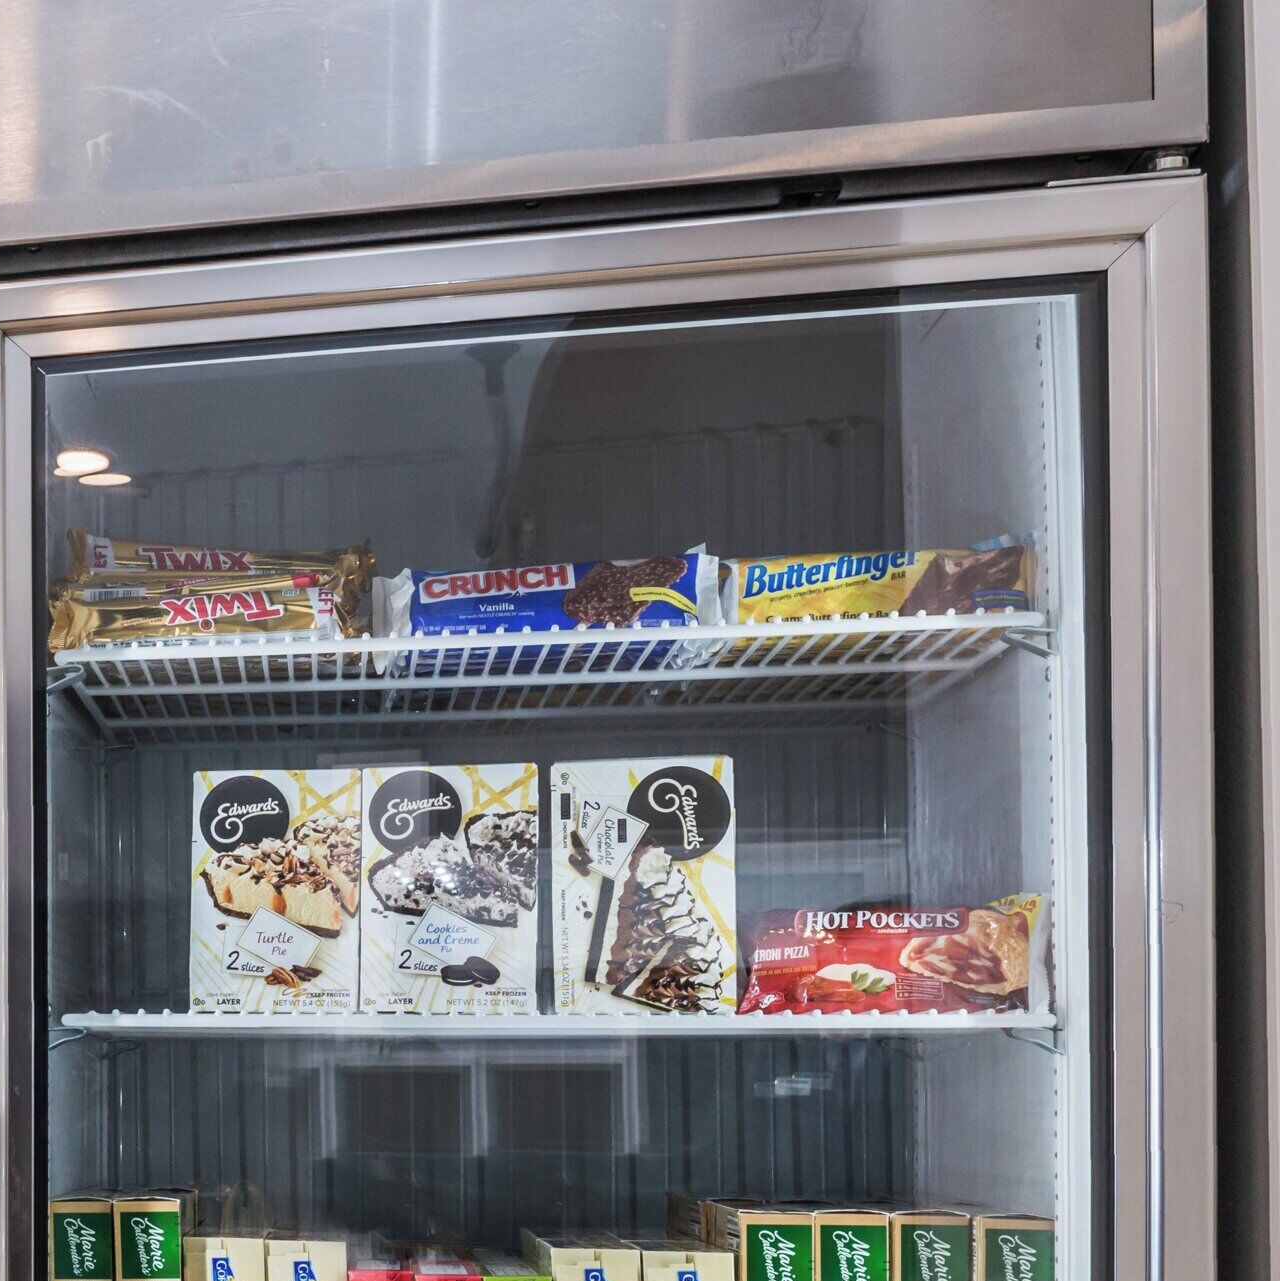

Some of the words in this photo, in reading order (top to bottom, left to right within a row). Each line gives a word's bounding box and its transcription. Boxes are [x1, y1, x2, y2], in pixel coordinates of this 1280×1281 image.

[423, 564, 571, 599] CRUNCH
[742, 550, 919, 599] Butterfinger
[891, 570, 906, 581] BAR
[478, 602, 515, 612] Vanilla
[210, 798, 280, 843] Edwards
[380, 793, 452, 840] Edwards
[648, 778, 704, 850] Edwards
[604, 818, 613, 866] Chocolate
[426, 923, 468, 935] Cookies
[806, 911, 853, 930] HOT
[856, 910, 959, 929] POCKETS
[255, 931, 294, 945] Turtle
[418, 935, 442, 945] and
[444, 934, 480, 945] Crème
[272, 944, 287, 956] Pie
[784, 946, 809, 959] PIZZA
[226, 950, 240, 971] 2
[241, 963, 265, 974] slices
[217, 997, 241, 1006] LAYER
[130, 1217, 150, 1277] Callender's
[145, 1217, 164, 1271] Marie
